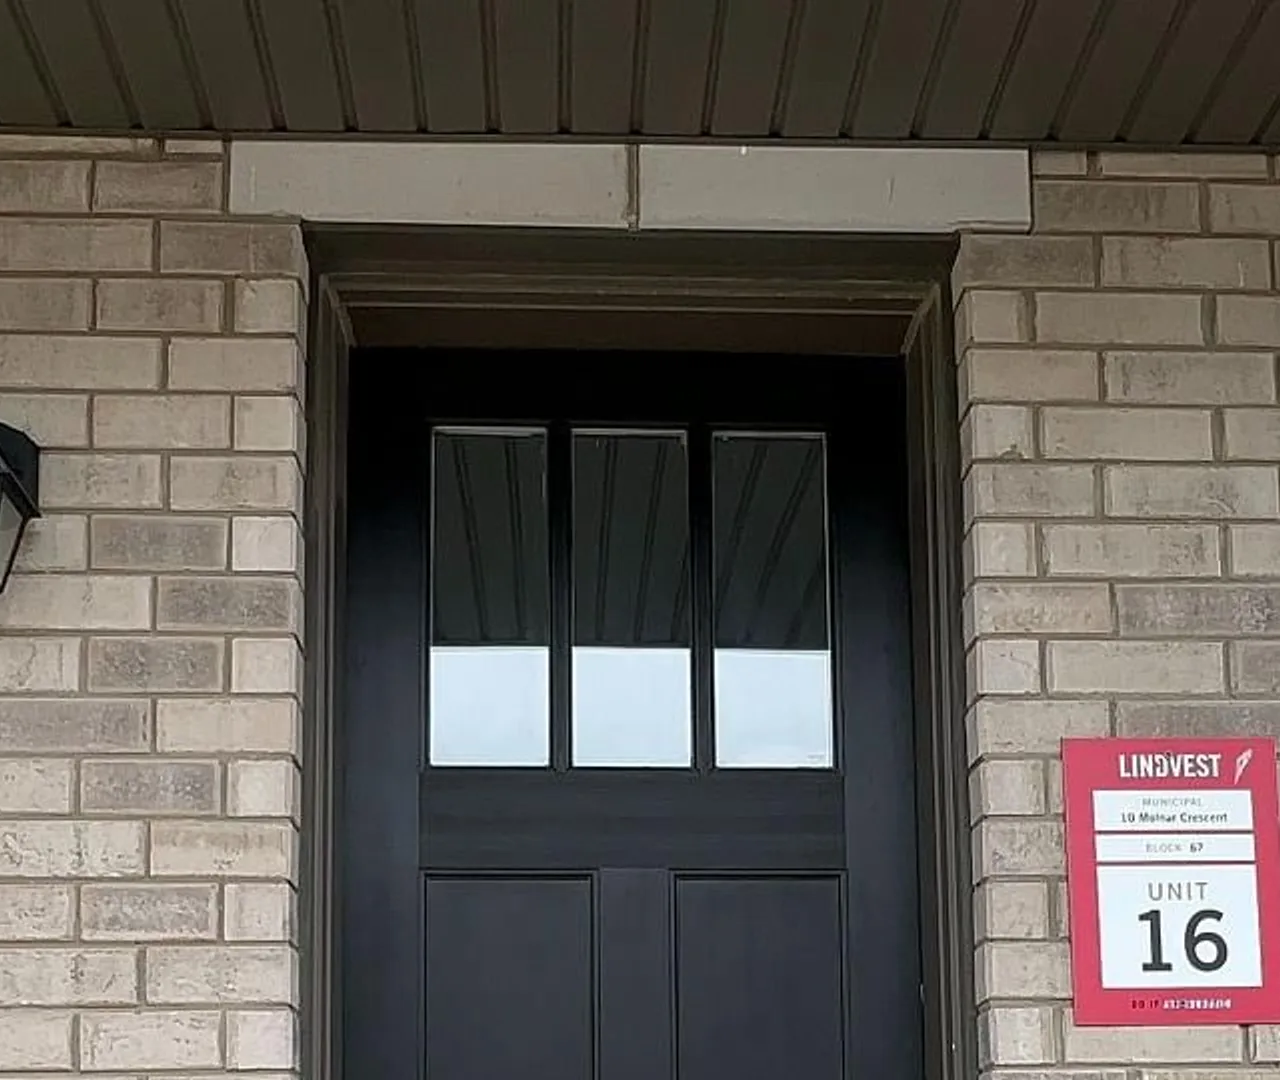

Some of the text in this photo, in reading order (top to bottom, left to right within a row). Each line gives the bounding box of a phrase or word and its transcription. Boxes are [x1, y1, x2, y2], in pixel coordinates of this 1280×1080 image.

[1120, 753, 1221, 778] LINDVEST
[1179, 811, 1228, 824] Crescent
[1147, 881, 1209, 901] UNIT
[1137, 908, 1228, 972] 16
